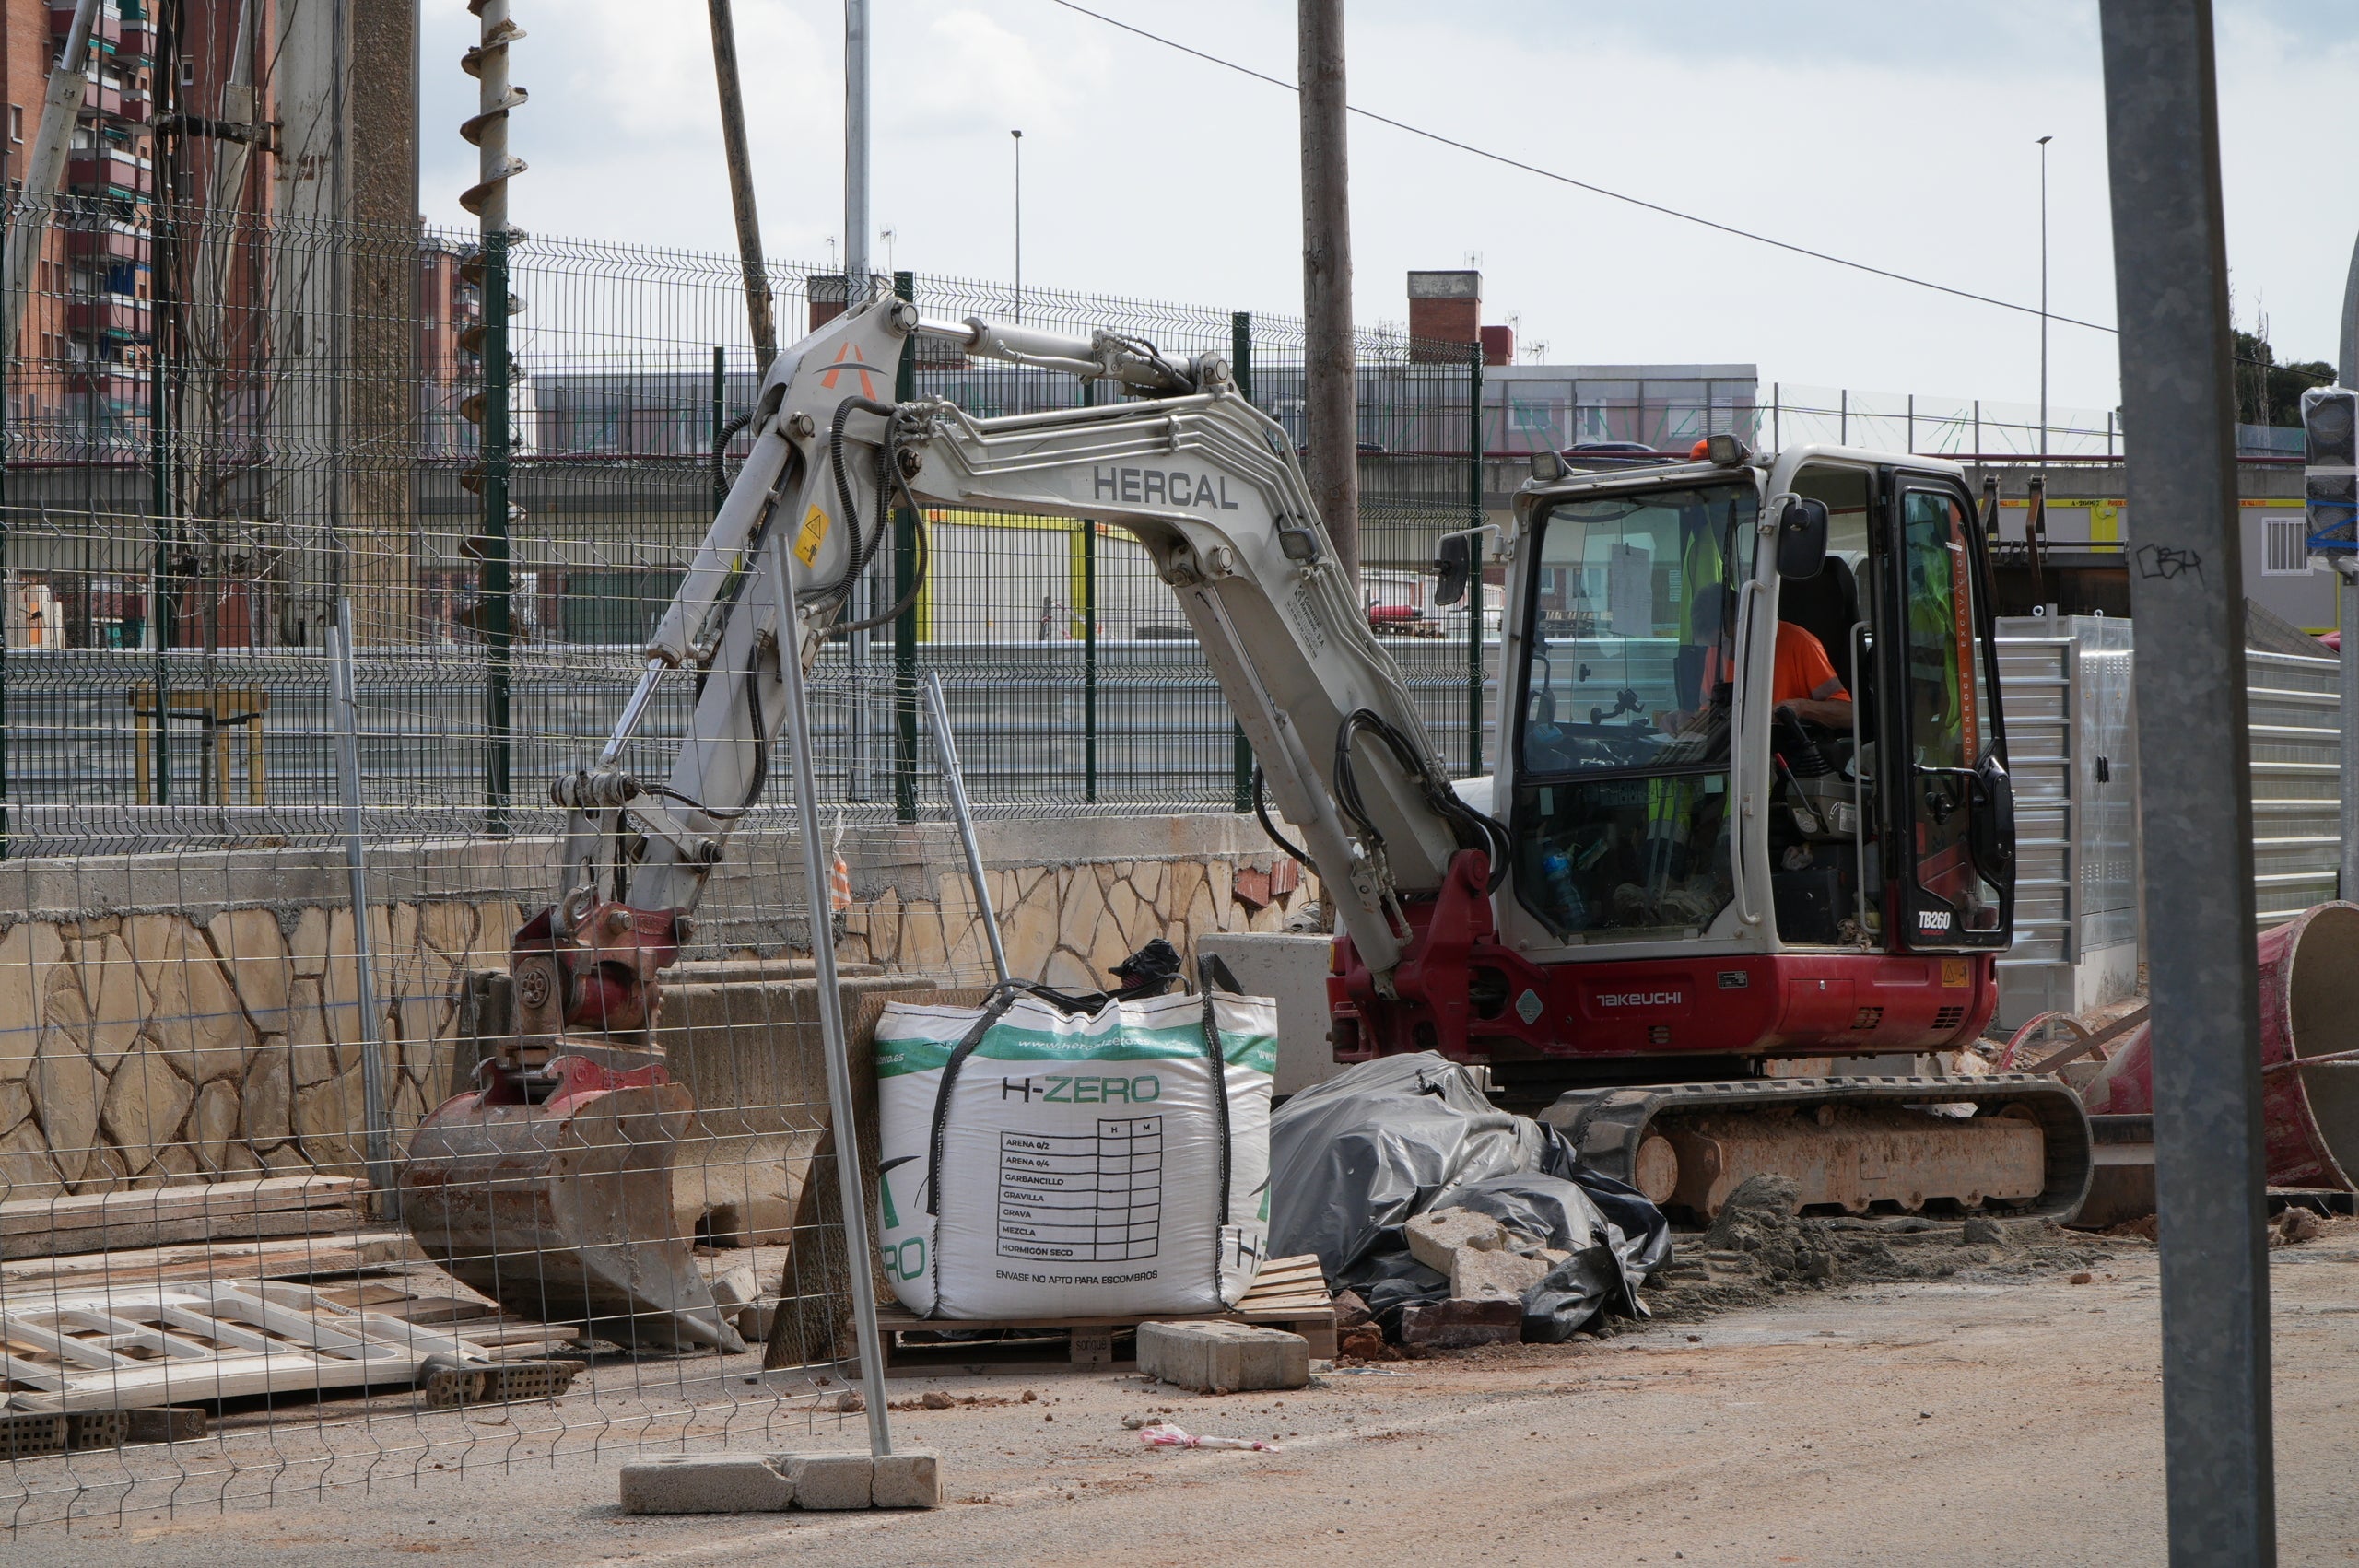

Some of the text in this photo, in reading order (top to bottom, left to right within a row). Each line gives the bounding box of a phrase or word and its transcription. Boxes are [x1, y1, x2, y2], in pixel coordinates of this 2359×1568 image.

[1094, 465, 1238, 510] HERCAL
[1919, 911, 1951, 929] TB260
[1002, 1075, 1160, 1104] H-ZERO
[1143, 1123, 1151, 1131] M
[1006, 1139, 1050, 1151] ARENA 0/2
[1005, 1156, 1050, 1168] ARENA 0/4
[1004, 1174, 1064, 1186] GARBANCILLO
[1003, 1191, 1044, 1202] GRAVILLA
[1003, 1209, 1032, 1219] GRAVA
[1002, 1225, 1036, 1236] MEZCLA
[1002, 1244, 1074, 1257] HORMIGÓN SECO
[996, 1270, 1158, 1284] ENVASE NO APTO PARA ESCOMBROS
